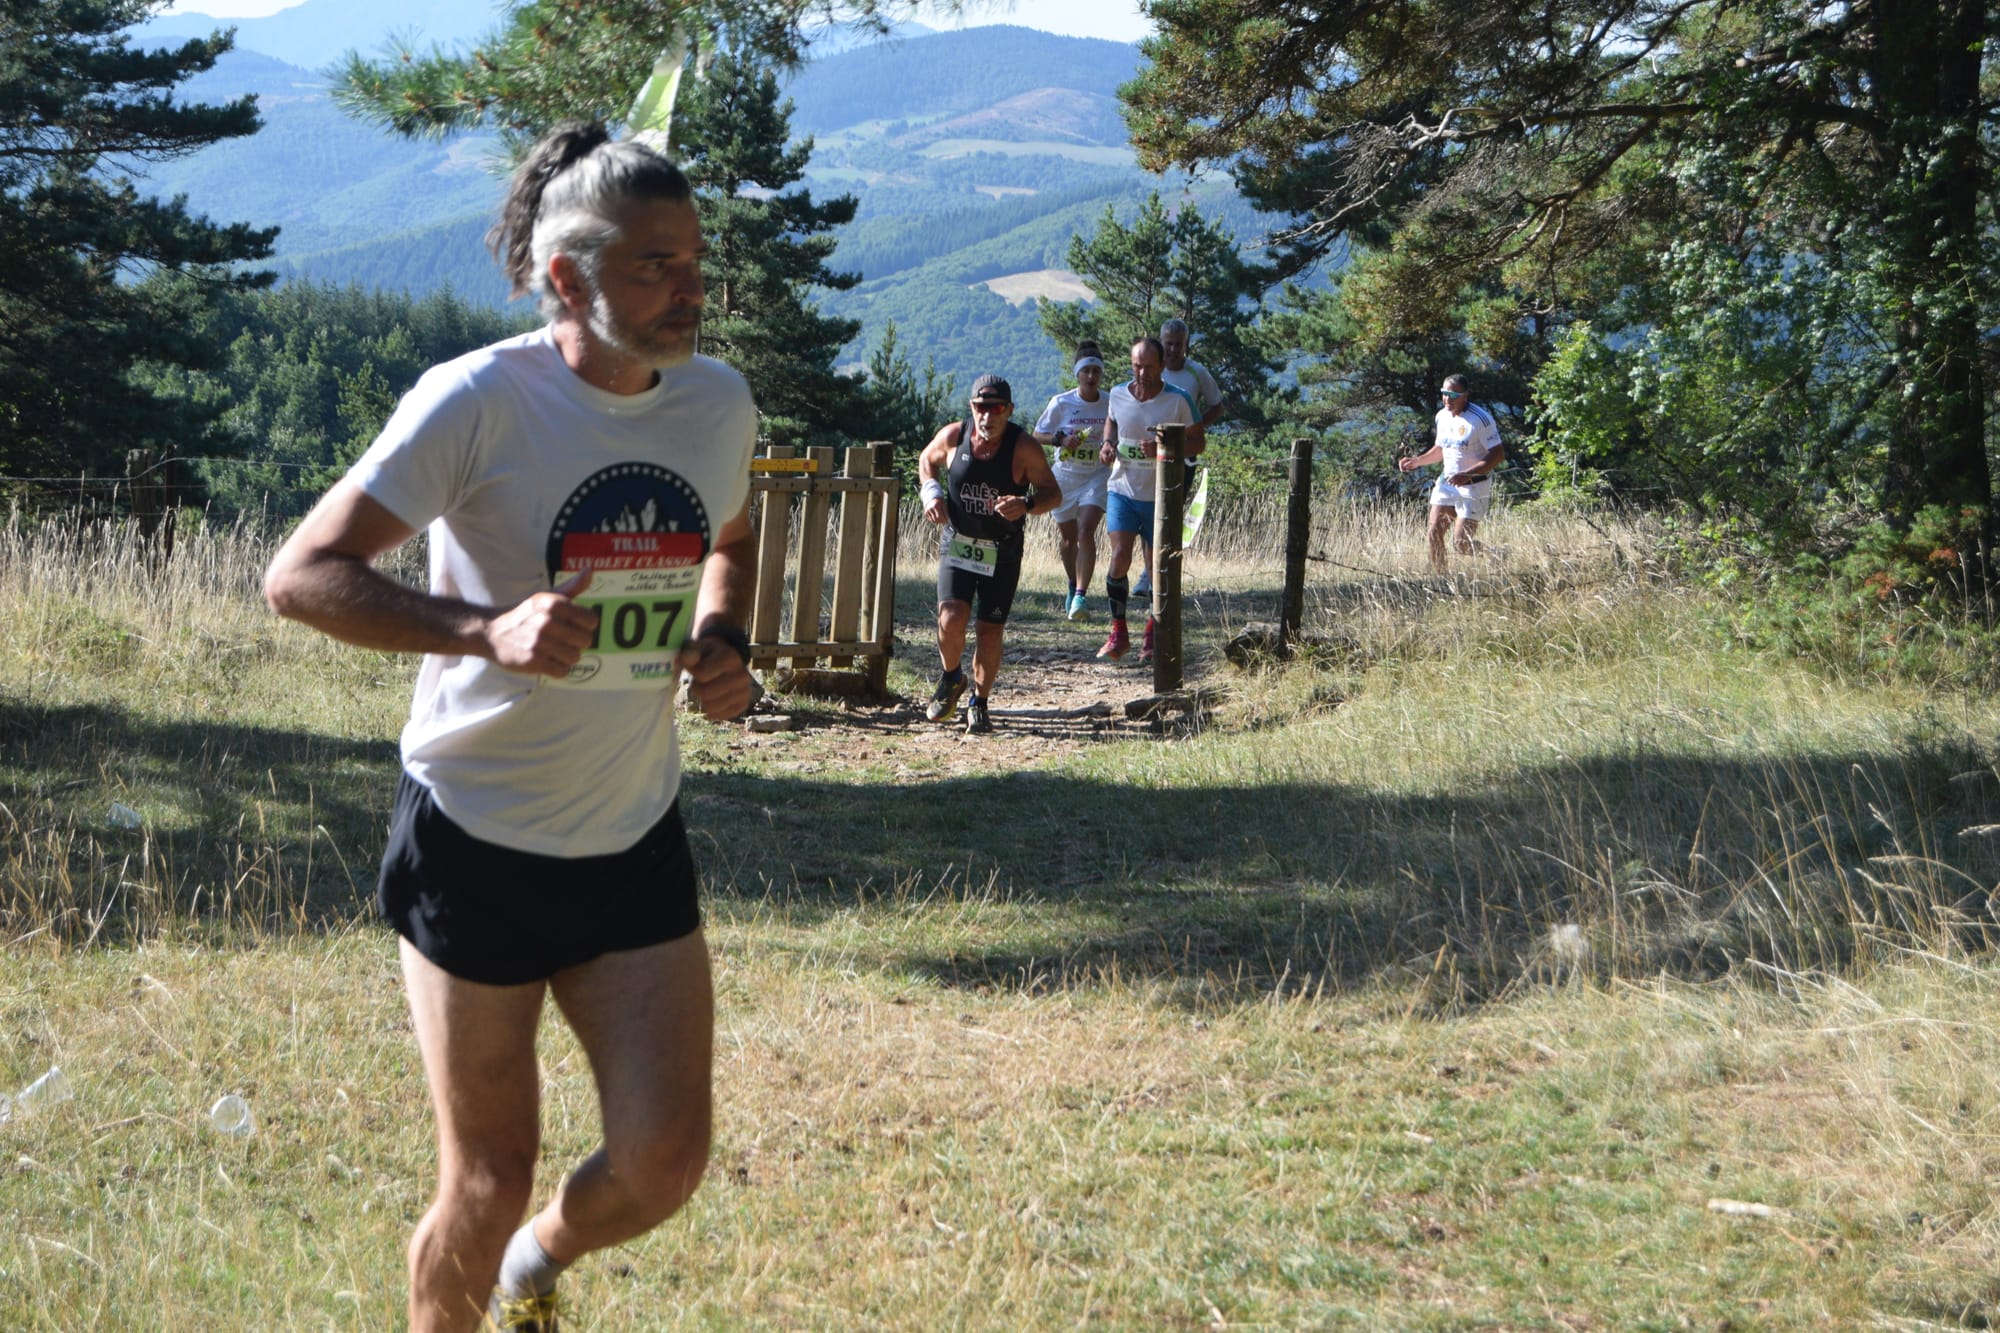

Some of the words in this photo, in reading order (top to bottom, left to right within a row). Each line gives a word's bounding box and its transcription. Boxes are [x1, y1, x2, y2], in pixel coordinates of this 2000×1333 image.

[611, 536, 660, 552] TRAIL
[961, 545, 985, 562] 39
[566, 556, 633, 570] NIVOLET
[636, 554, 698, 569] CLASSIC
[588, 600, 683, 649] 107
